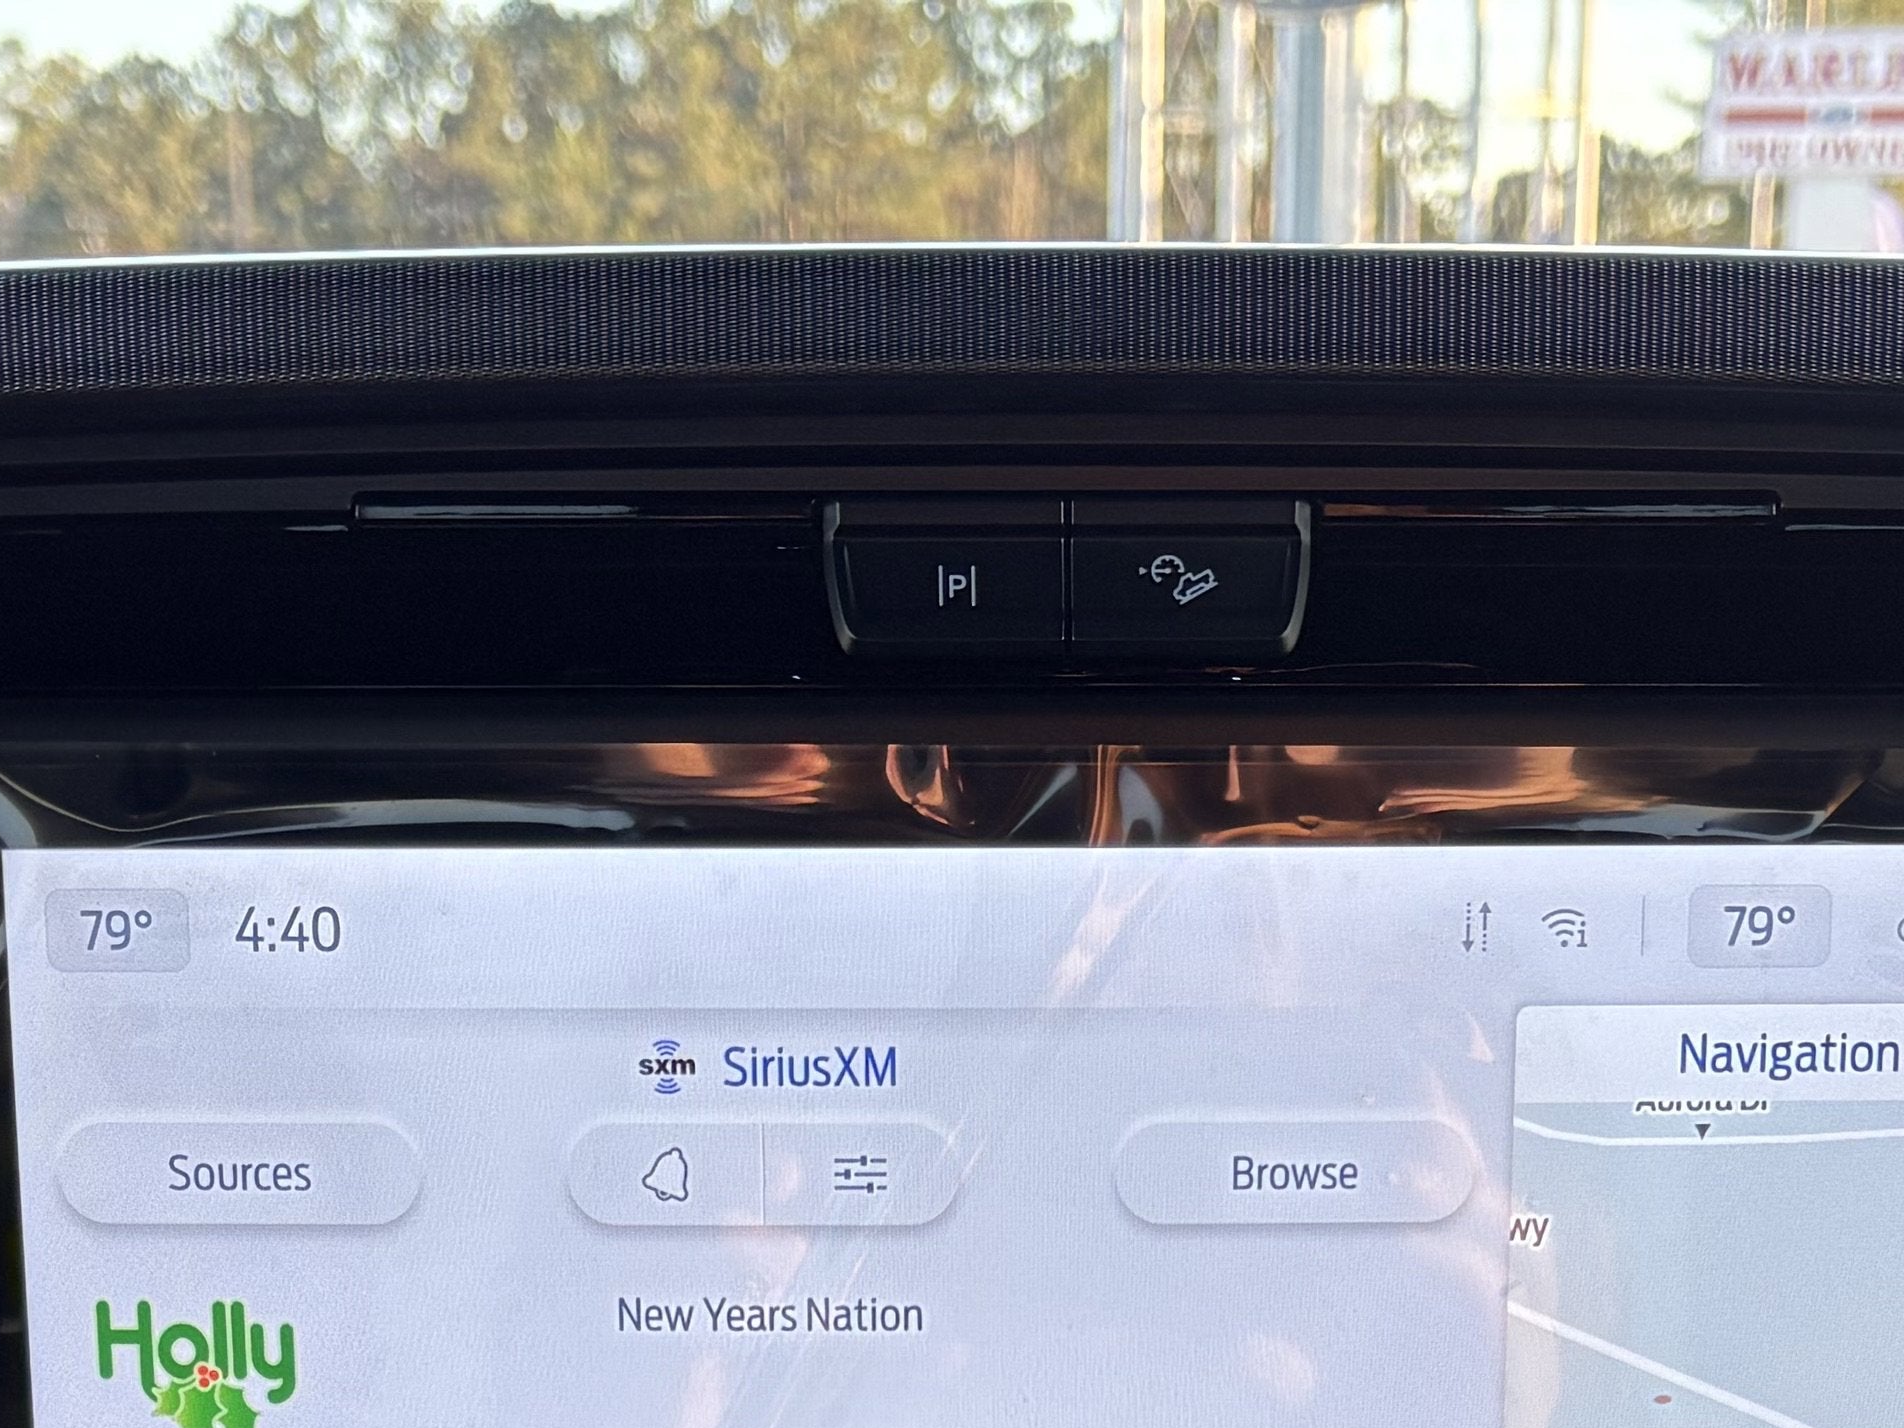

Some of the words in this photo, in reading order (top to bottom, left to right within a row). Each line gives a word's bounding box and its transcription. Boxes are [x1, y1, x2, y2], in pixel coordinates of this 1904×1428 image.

[80, 907, 153, 952] 79°
[235, 906, 341, 953] 4:40
[1723, 906, 1795, 946] 79°
[638, 1054, 696, 1076] sxm
[722, 1046, 898, 1088] SiriusXM
[1679, 1033, 1900, 1080] Navigation
[167, 1153, 311, 1192] Sources
[1232, 1156, 1358, 1191] Browse
[617, 1298, 693, 1333] New
[703, 1298, 796, 1333] Years
[806, 1298, 924, 1333] Nation
[93, 1298, 297, 1405] Holly
